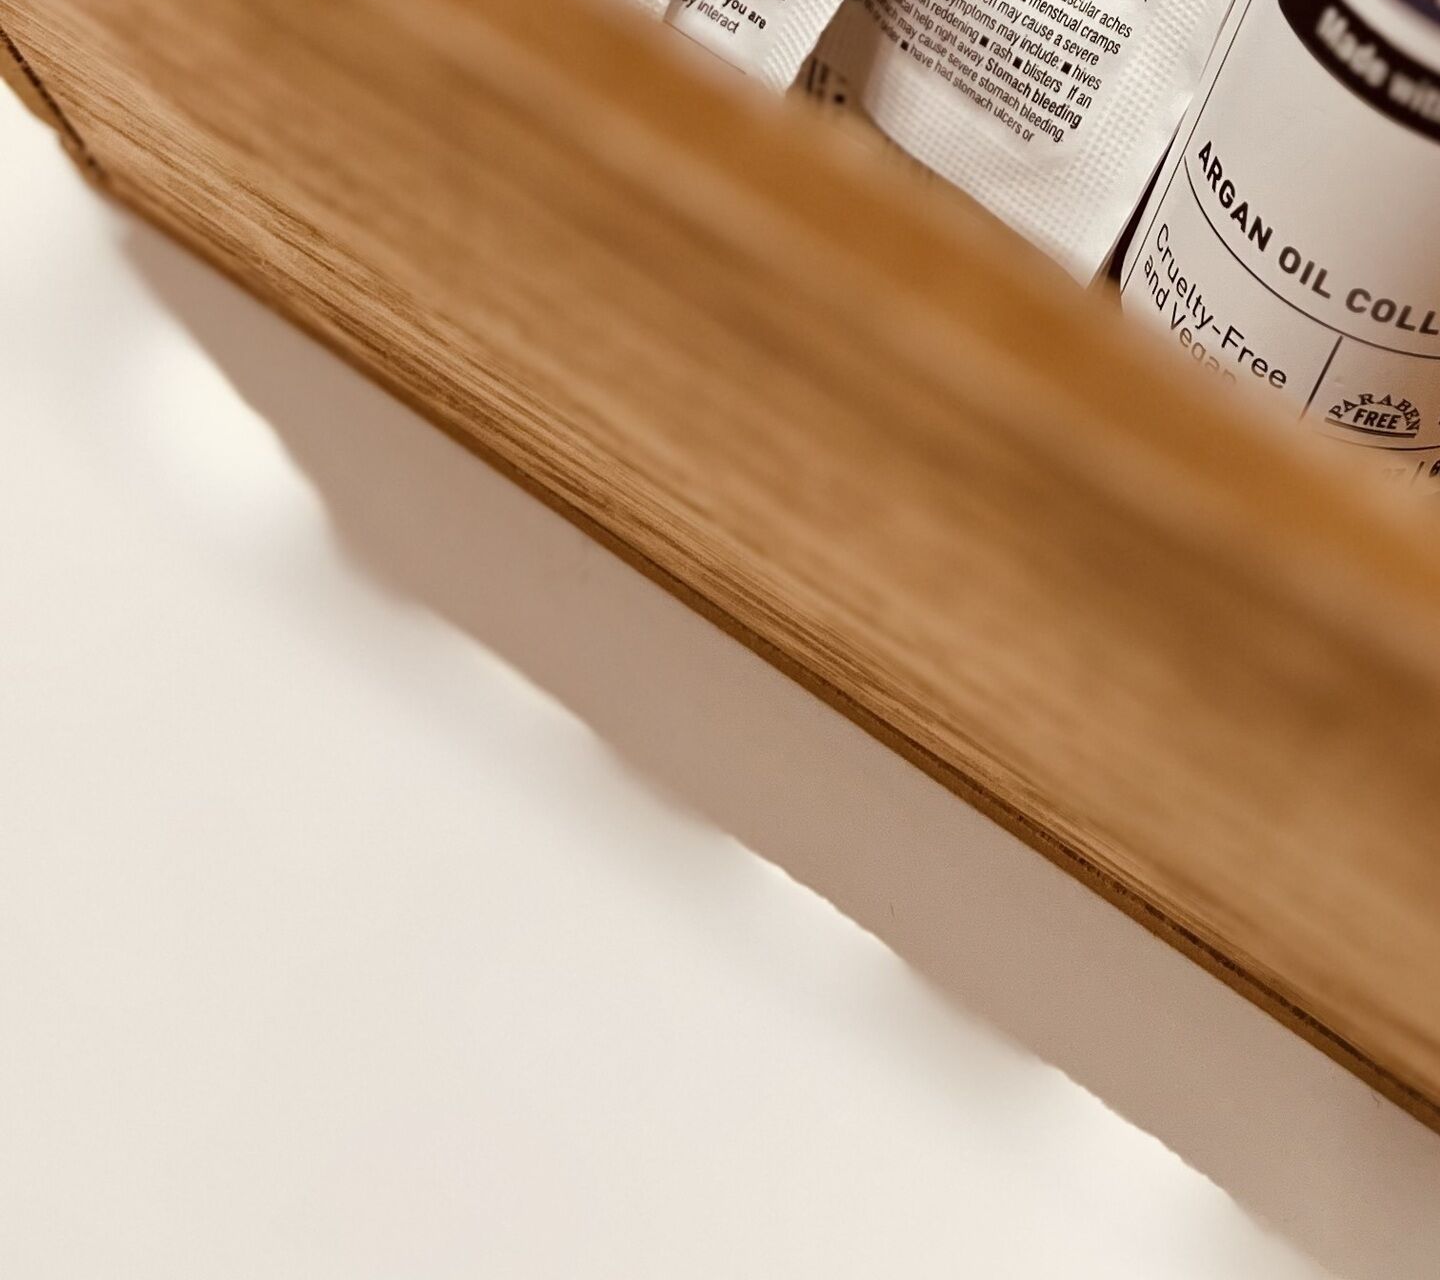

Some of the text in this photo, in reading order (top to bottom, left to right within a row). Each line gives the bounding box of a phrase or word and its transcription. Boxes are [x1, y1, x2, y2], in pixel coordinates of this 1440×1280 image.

[745, 10, 768, 30] are
[996, 0, 1022, 22] may
[1020, 13, 1055, 40] cause
[1053, 33, 1064, 46] a
[1062, 38, 1100, 67] severe
[1078, 25, 1121, 58] cramps
[1099, 11, 1134, 38] aches
[1315, 5, 1383, 86] Made
[909, 10, 935, 33] help
[931, 24, 959, 48] right
[983, 58, 1034, 96] Stomach
[1029, 89, 1083, 129] bleeding
[927, 3, 981, 42] reddening
[987, 40, 1014, 62] rash
[1021, 61, 1064, 93] blisters
[1065, 85, 1081, 103] If
[1075, 92, 1093, 110] an
[945, 53, 982, 81] severe
[977, 76, 1022, 110] stomach
[995, 22, 1021, 45] may
[1071, 66, 1102, 91] hives
[949, 76, 996, 112] stomach
[990, 106, 1025, 134] ulcers
[1198, 140, 1274, 252] ARGAN
[1278, 245, 1332, 299] OIL
[1143, 254, 1170, 312] and
[1157, 224, 1288, 390] Cruelty-Free
[1328, 392, 1420, 433] PARABEN
[1353, 408, 1400, 431] FREE
